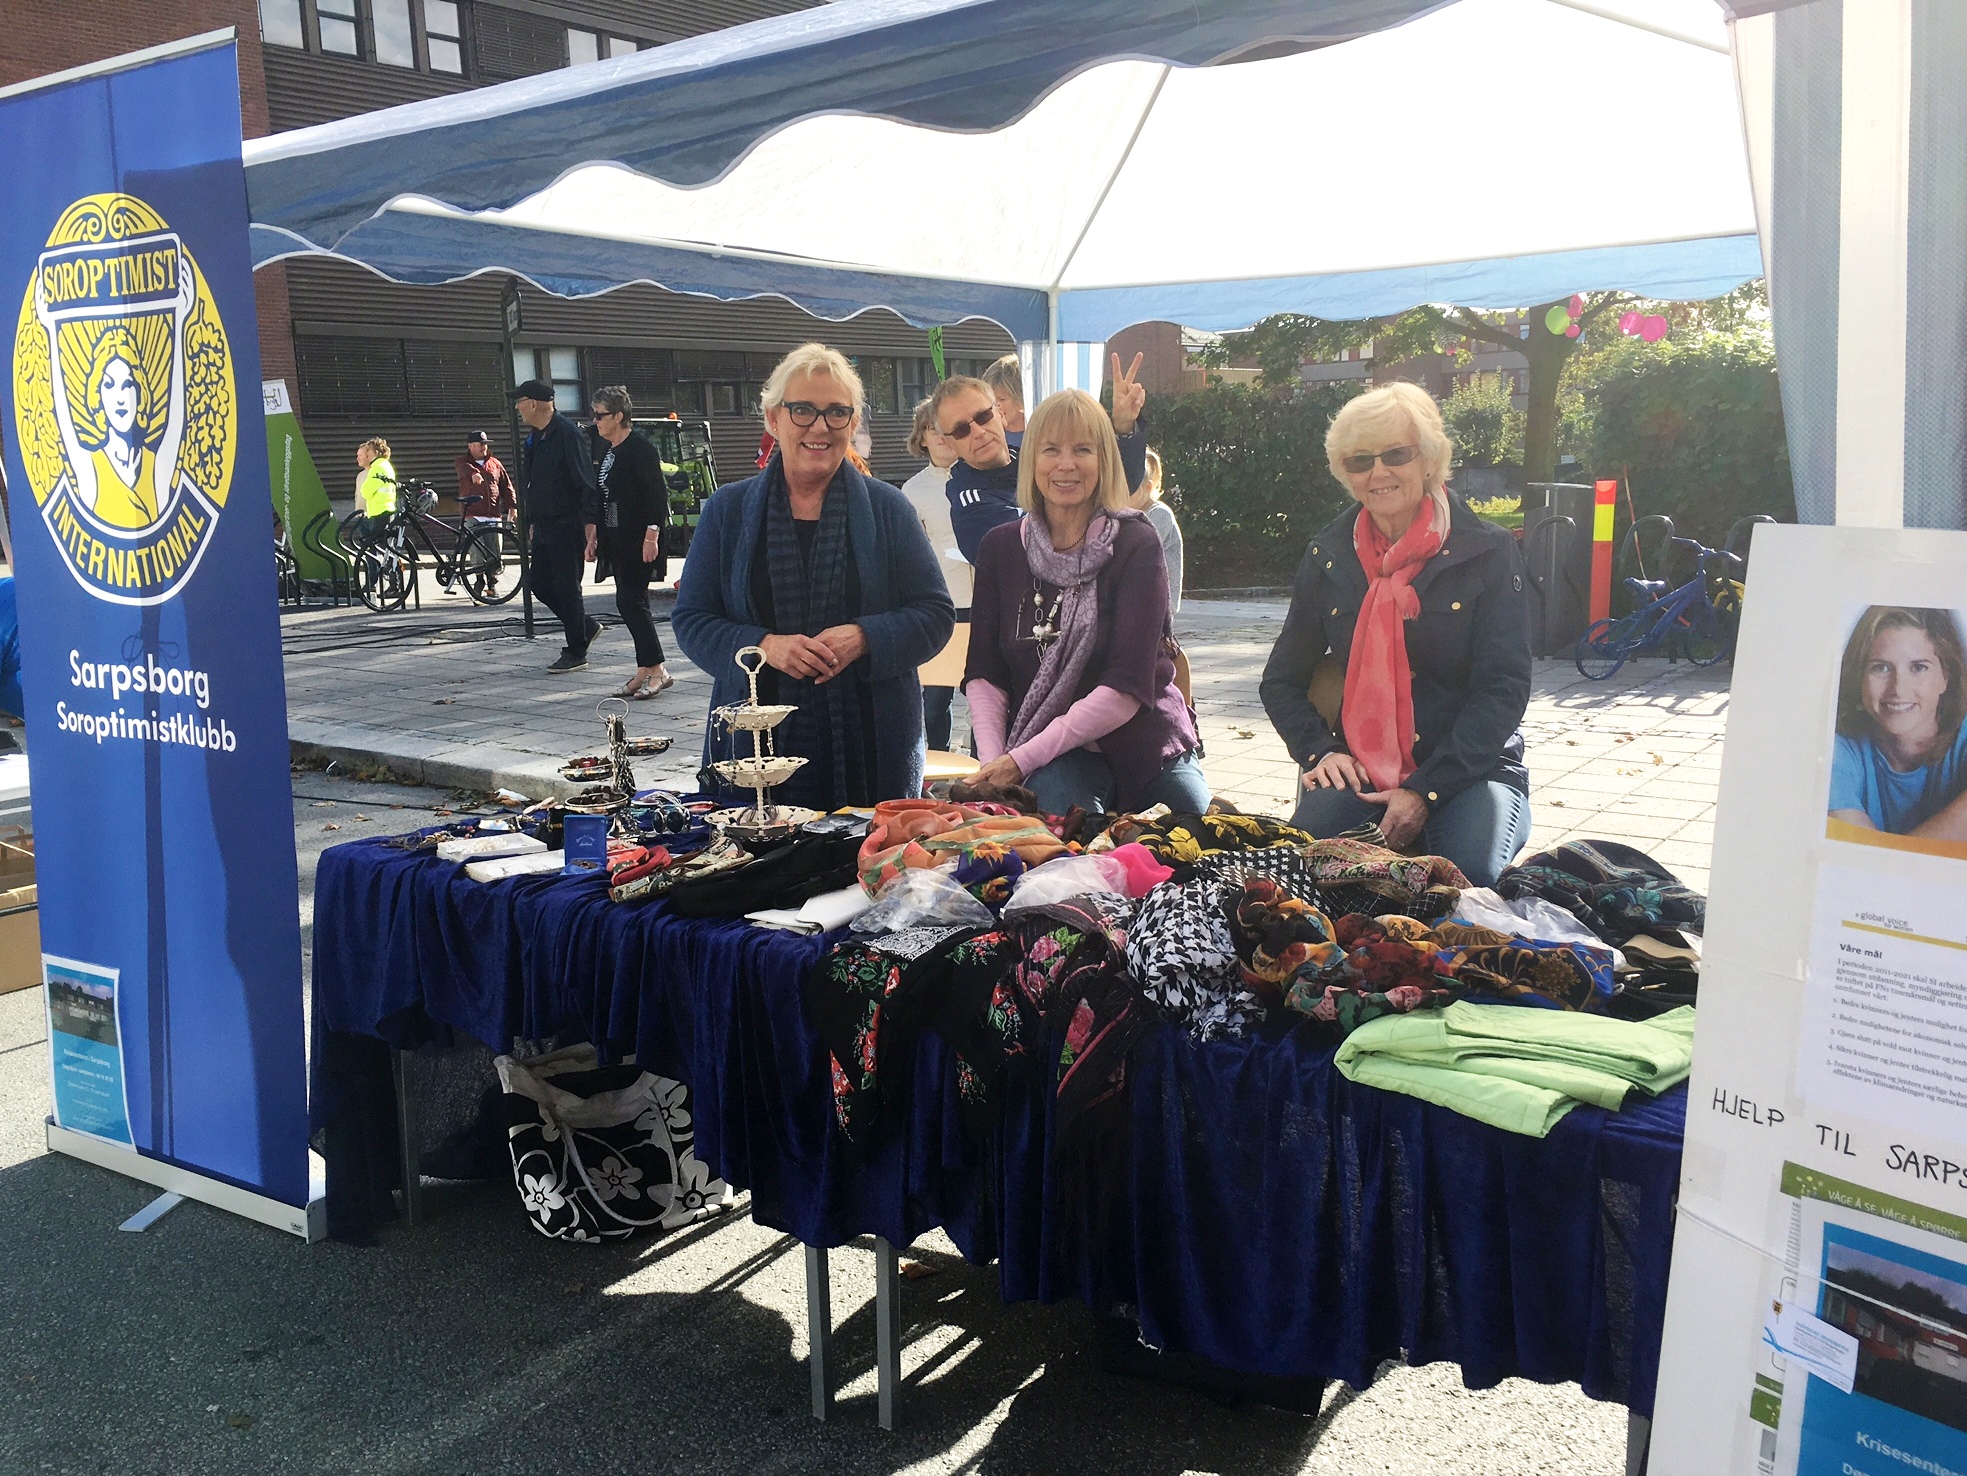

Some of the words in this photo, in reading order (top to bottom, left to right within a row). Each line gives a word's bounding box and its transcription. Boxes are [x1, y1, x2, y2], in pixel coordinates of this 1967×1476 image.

[43, 249, 178, 304] SOROPTIMIST
[55, 495, 205, 588] INTERNATIONAL
[69, 649, 210, 708] Sarpsborg
[56, 701, 237, 752] Soroptimistklubb
[1860, 912, 1885, 922] global
[1887, 918, 1908, 927] voice
[1840, 943, 1862, 954] Våre
[1864, 950, 1882, 959] mål
[1842, 960, 1874, 972] perioden
[1912, 974, 1928, 983] skal
[1712, 1087, 1785, 1127] HJELP
[1816, 1124, 1857, 1156] TIL
[1828, 1190, 1852, 1206] VÅGE
[1856, 1198, 1862, 1208] Å
[1864, 1202, 1877, 1212] SE
[1881, 1208, 1907, 1223] VÅGE
[1856, 1431, 1967, 1476] Krisesente
